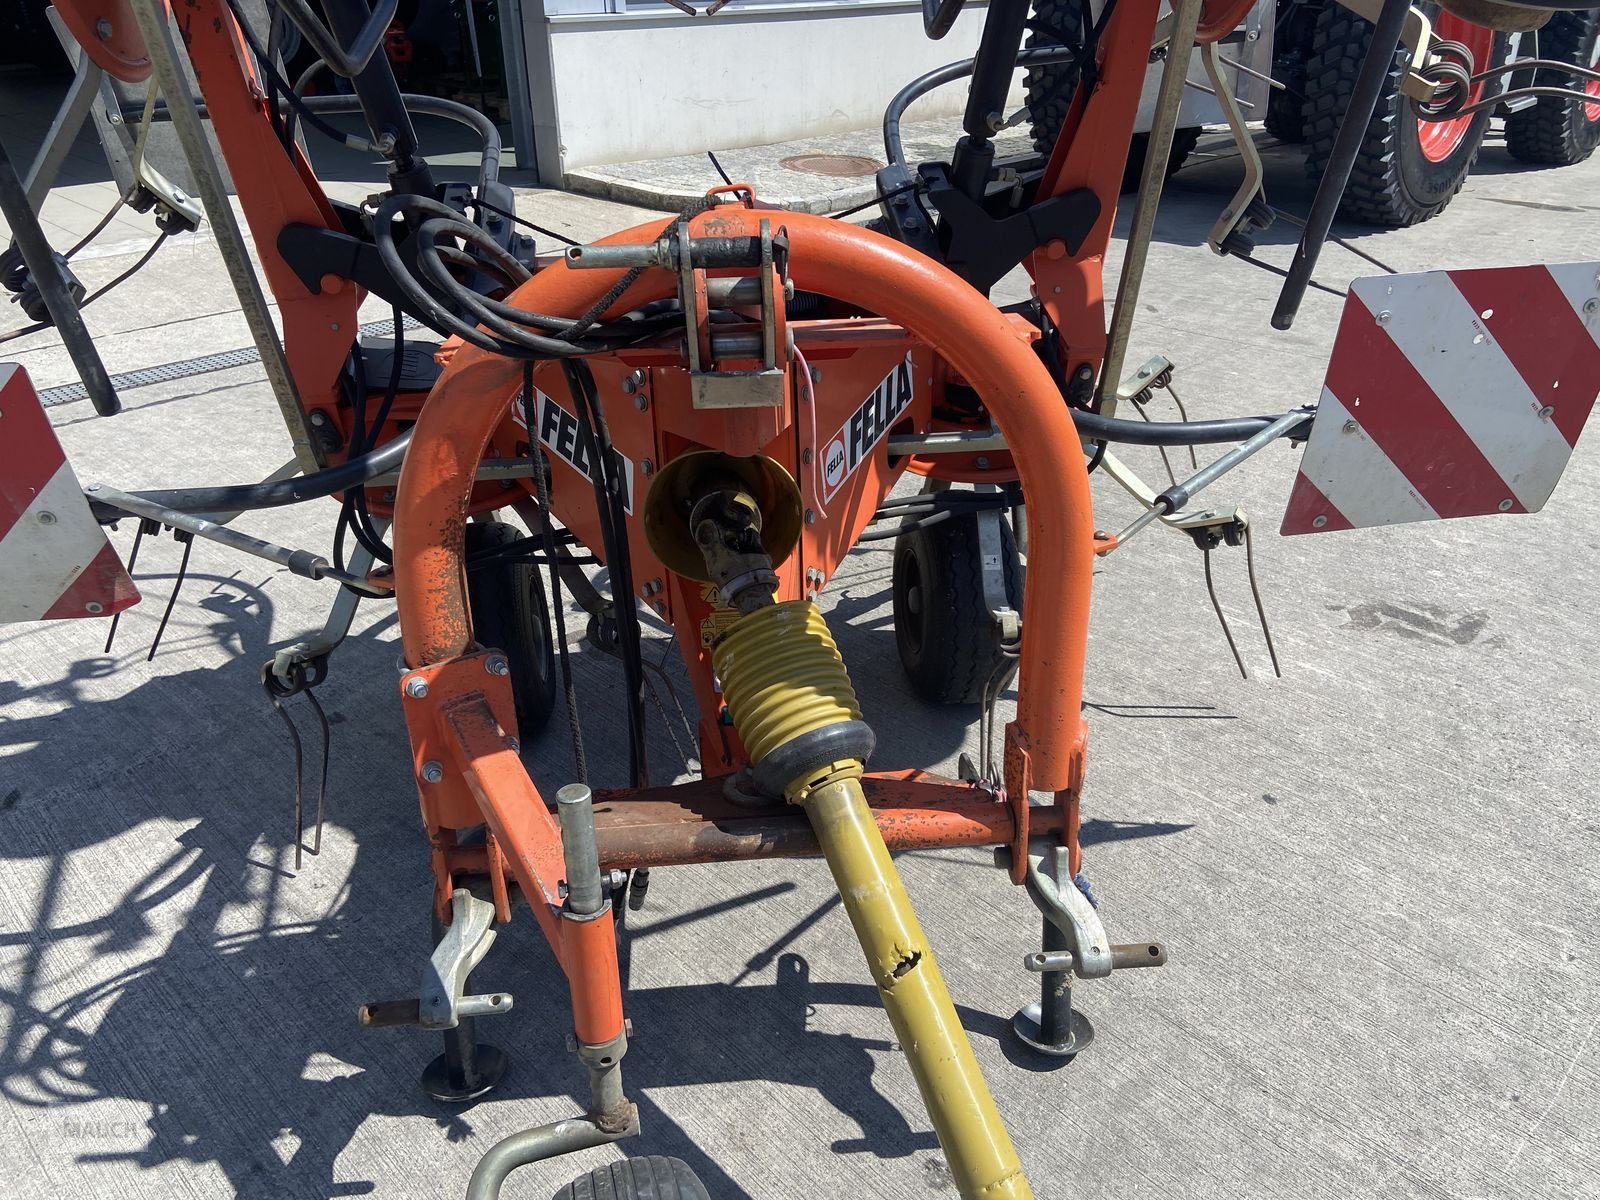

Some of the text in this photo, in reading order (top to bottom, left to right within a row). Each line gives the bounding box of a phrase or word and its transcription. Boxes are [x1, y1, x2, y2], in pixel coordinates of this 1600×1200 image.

[541, 397, 630, 511] FEL
[827, 450, 844, 478] FELLA
[850, 354, 912, 471] FELLA
